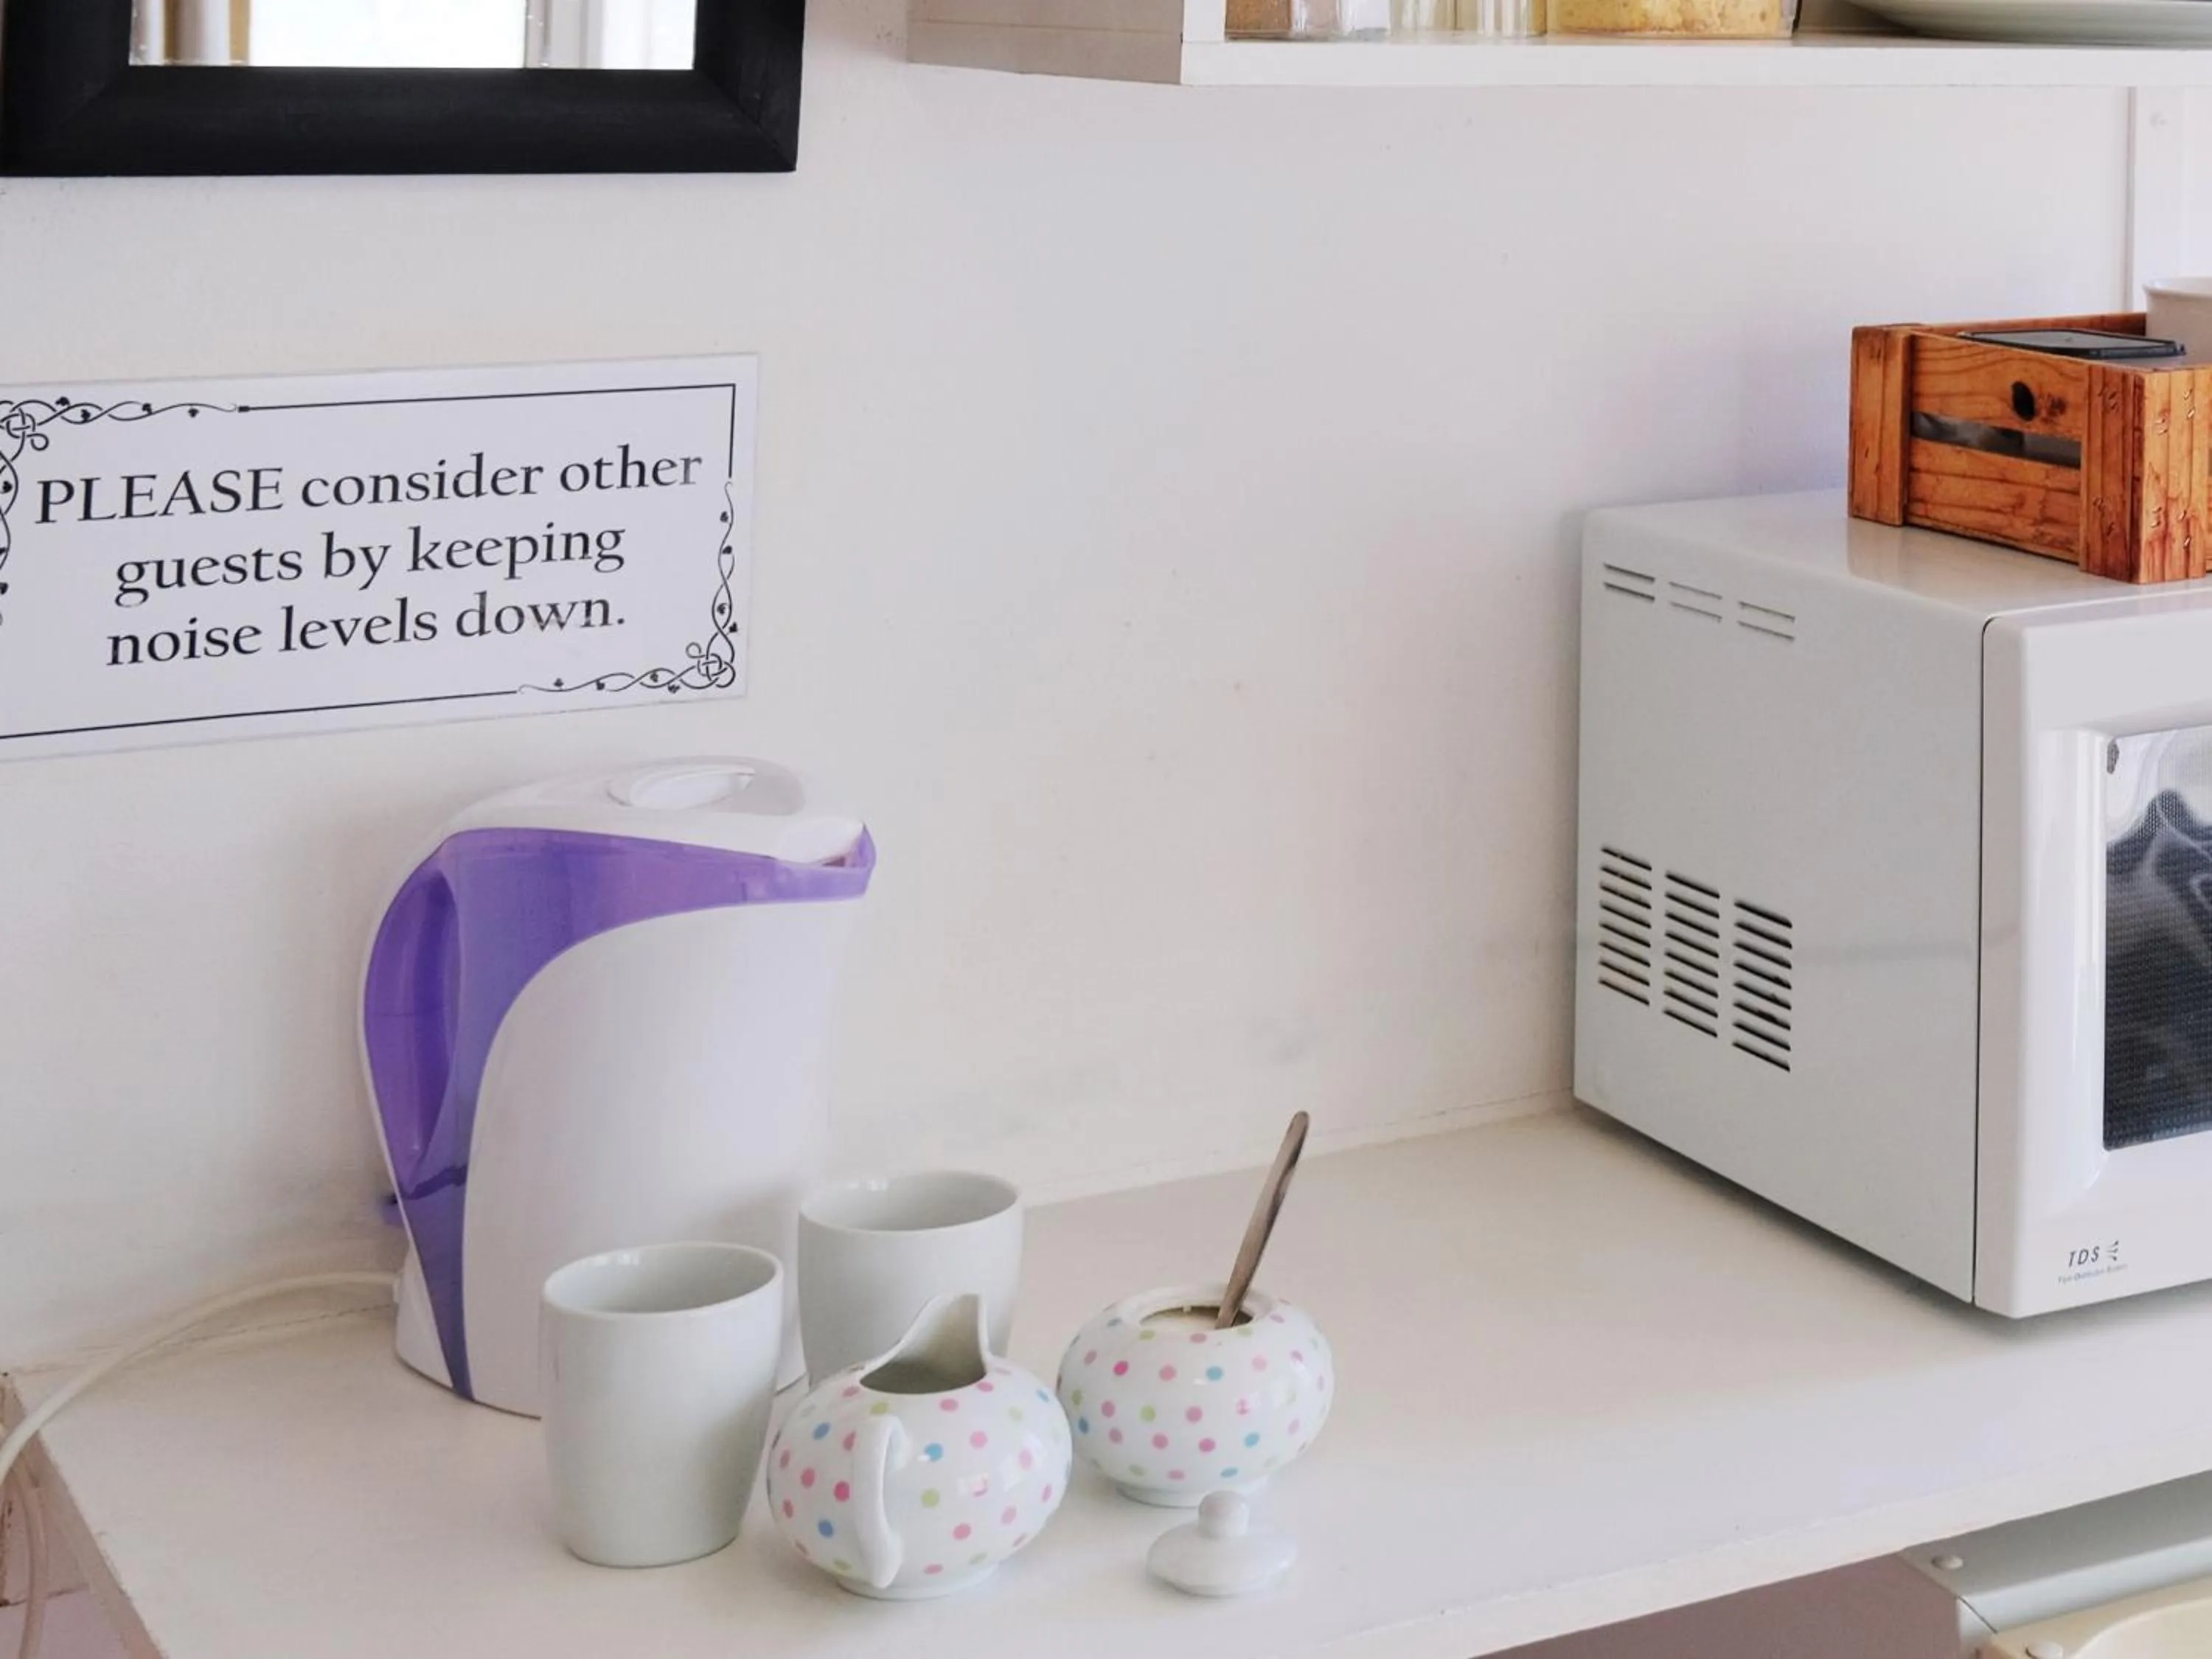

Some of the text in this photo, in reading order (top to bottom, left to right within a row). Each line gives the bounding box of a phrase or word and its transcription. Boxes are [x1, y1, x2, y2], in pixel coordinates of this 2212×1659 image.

[35, 443, 703, 524] PLEASE consider other
[114, 521, 626, 607] guests by keeping
[106, 590, 625, 666] noise levels down.
